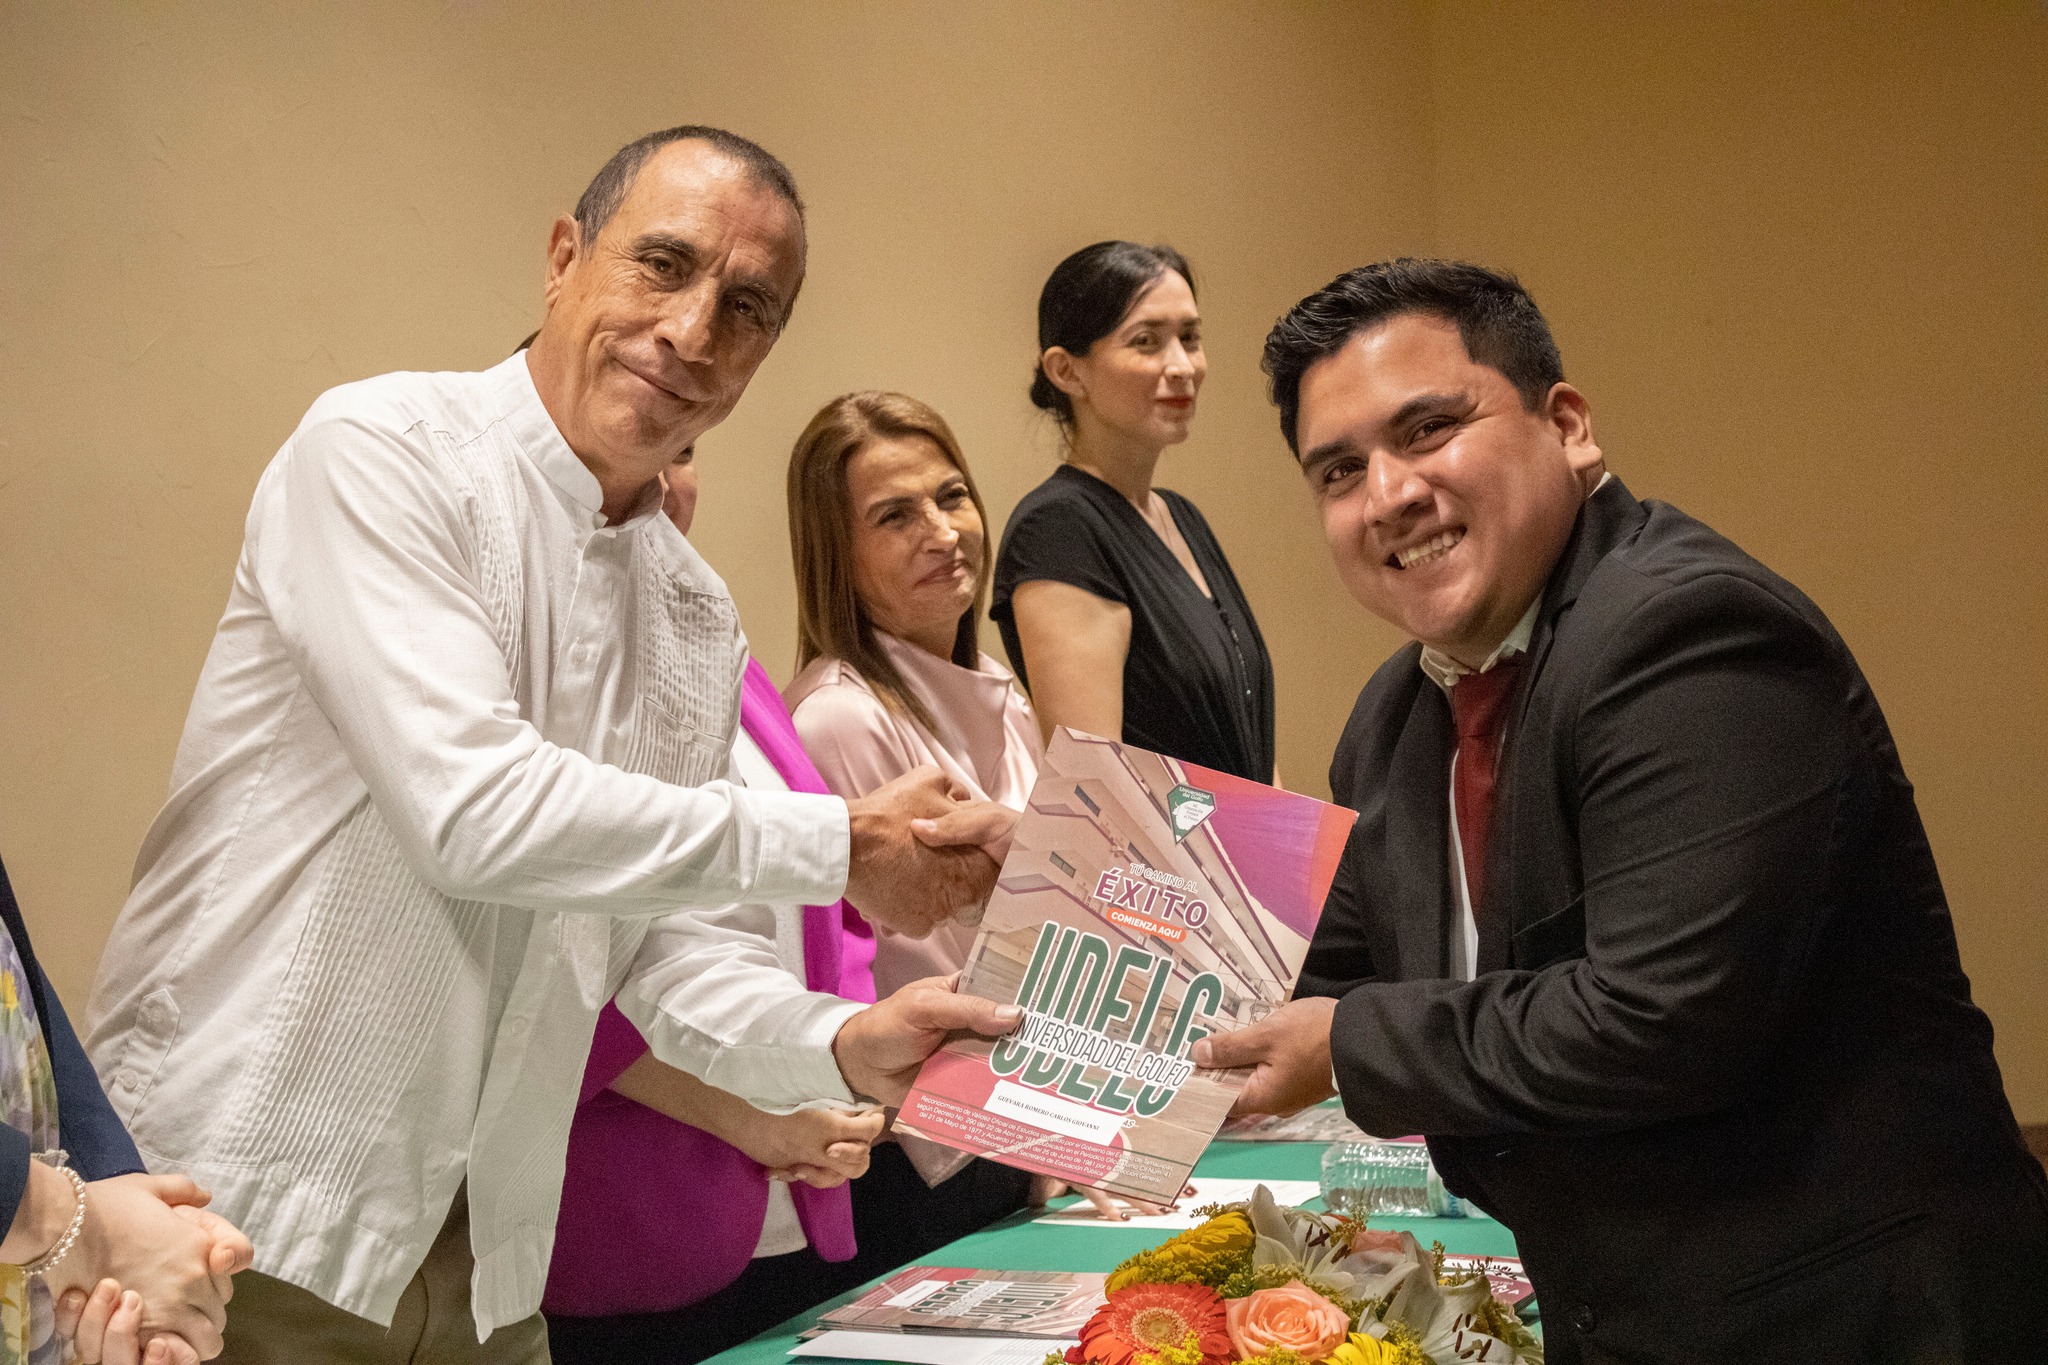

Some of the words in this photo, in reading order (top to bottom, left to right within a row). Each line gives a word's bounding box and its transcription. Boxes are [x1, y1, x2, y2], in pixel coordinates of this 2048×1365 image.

[1130, 862, 1146, 876] TÚ
[1143, 868, 1185, 888] CAMINO
[1183, 881, 1198, 894] AL
[1093, 866, 1209, 928] ÉXITO
[1111, 912, 1157, 932] COMIENZA
[1158, 926, 1183, 940] AQUÍ
[990, 921, 1223, 1117] UDELG
[1008, 1012, 1108, 1065] NIVERSIDAD
[1108, 1044, 1137, 1075] DEL
[1137, 1053, 1191, 1087] GOLFO
[920, 1095, 964, 1112] Reconocimiento
[970, 1111, 991, 1122] Validez
[933, 1107, 955, 1118] Decreto
[943, 1119, 959, 1129] Mayo
[997, 1095, 1025, 1108] GUEVARA
[1024, 1104, 1050, 1116] ROMERO
[1049, 1112, 1072, 1122] CARLOS
[1072, 1119, 1100, 1130] GIOVANNI
